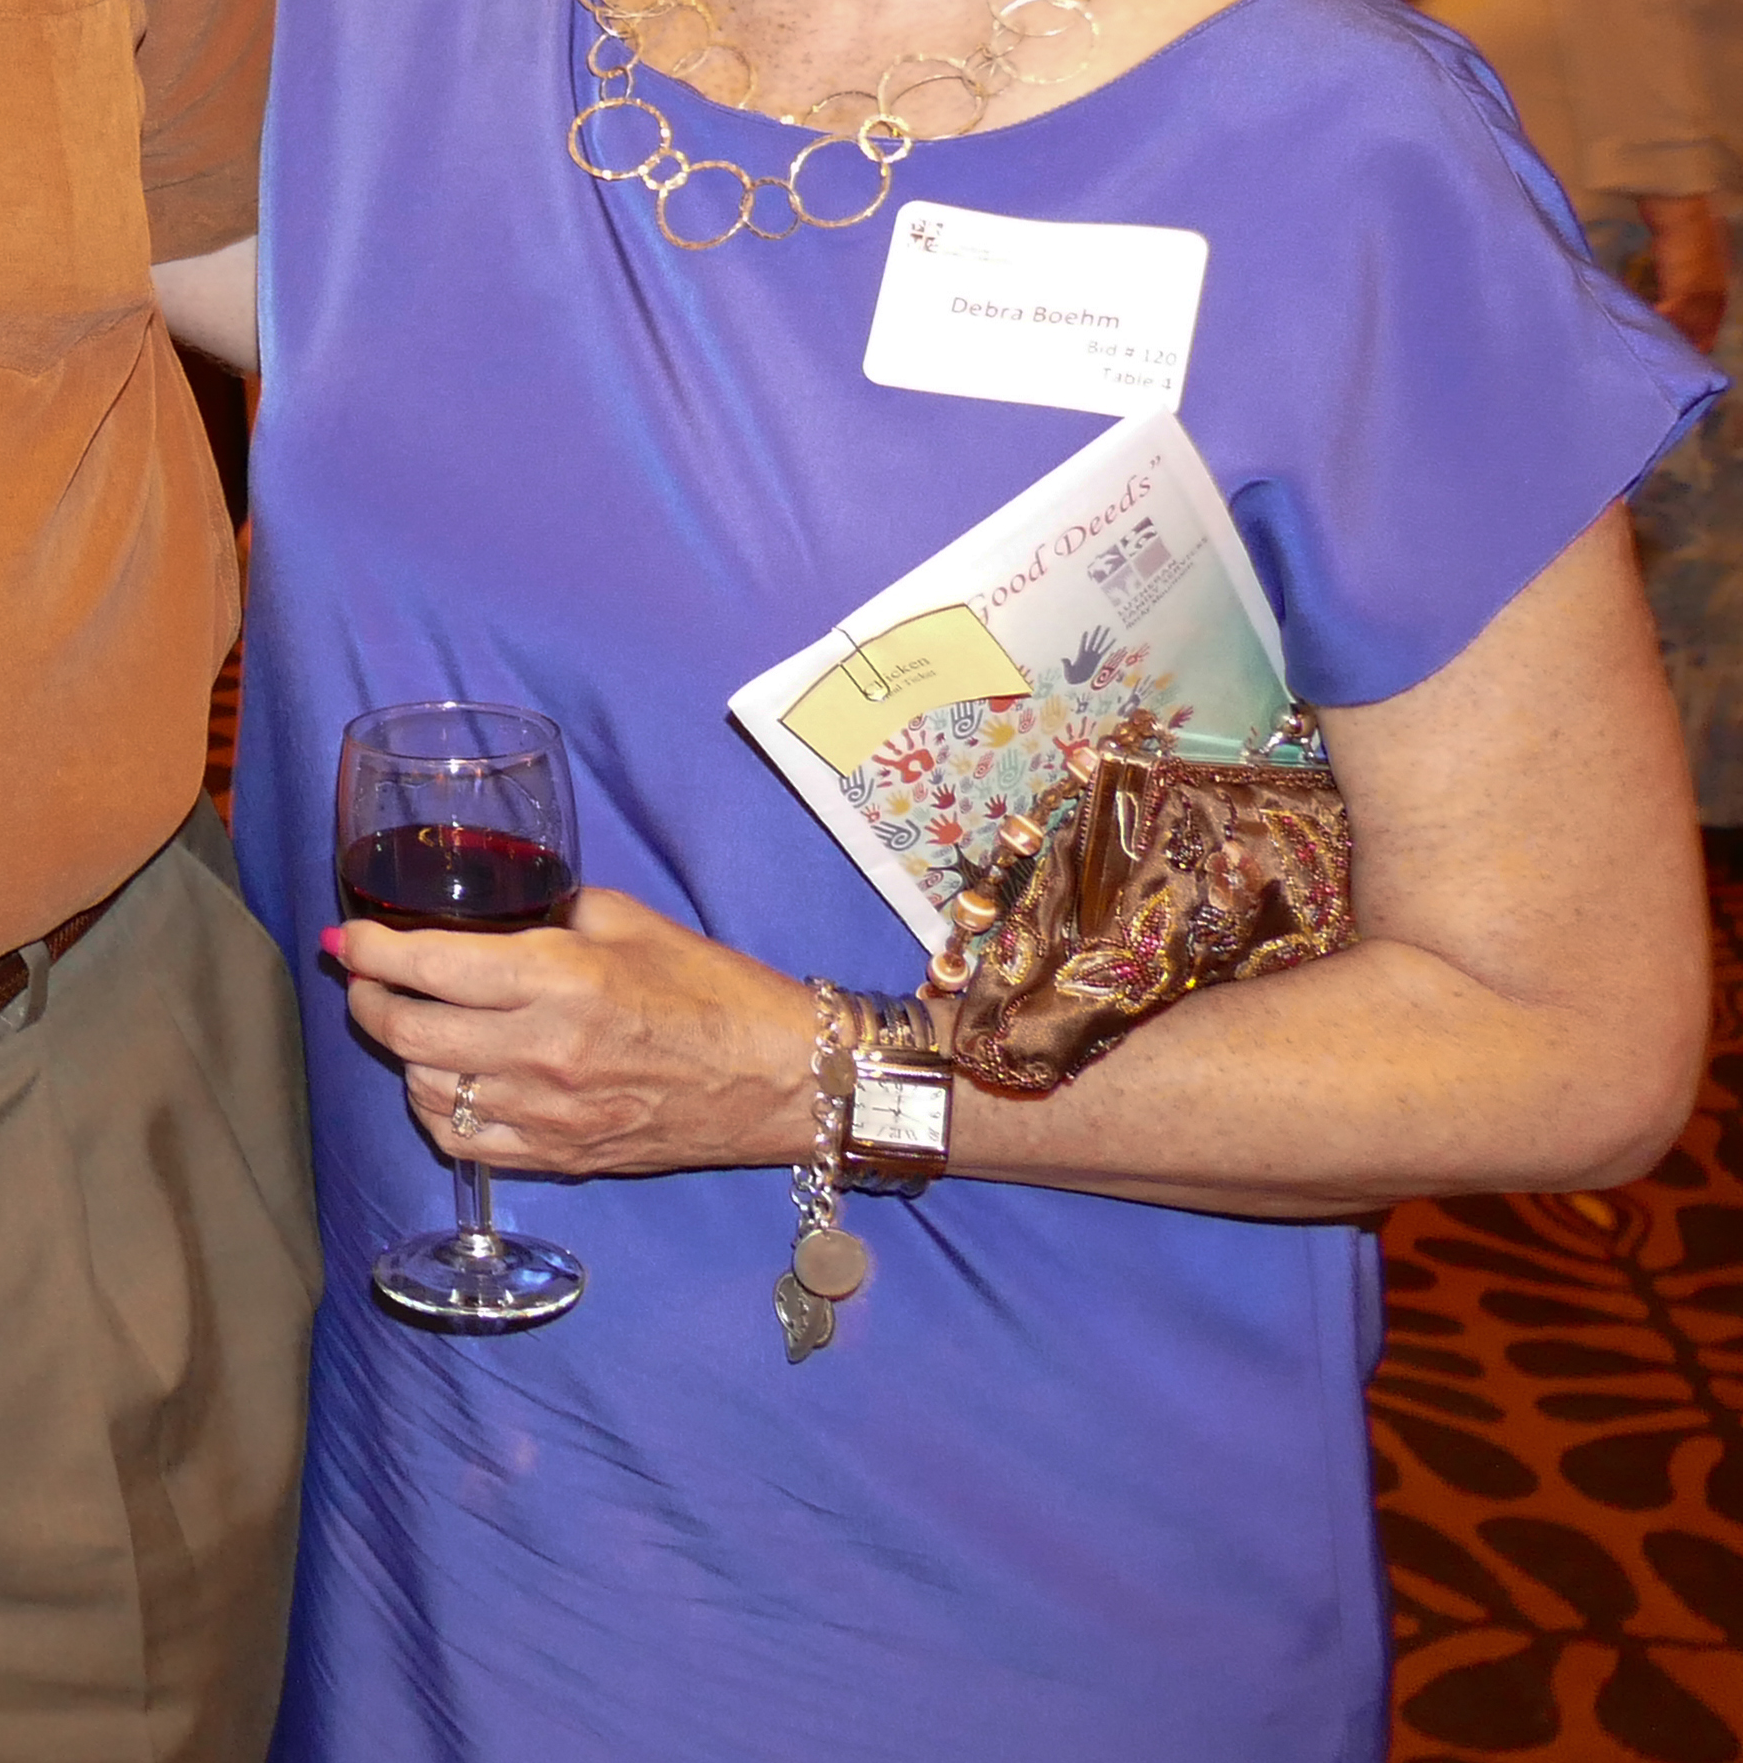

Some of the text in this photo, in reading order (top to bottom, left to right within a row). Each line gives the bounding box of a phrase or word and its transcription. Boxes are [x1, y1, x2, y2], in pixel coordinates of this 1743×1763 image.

[950, 297, 1120, 330] Debra Boehm
[1087, 339, 1117, 356] Bid
[1145, 349, 1177, 366] 120
[1103, 367, 1154, 387] Table
[1117, 559, 1177, 617] LUTHERAN
[1122, 584, 1160, 623] FAMILY
